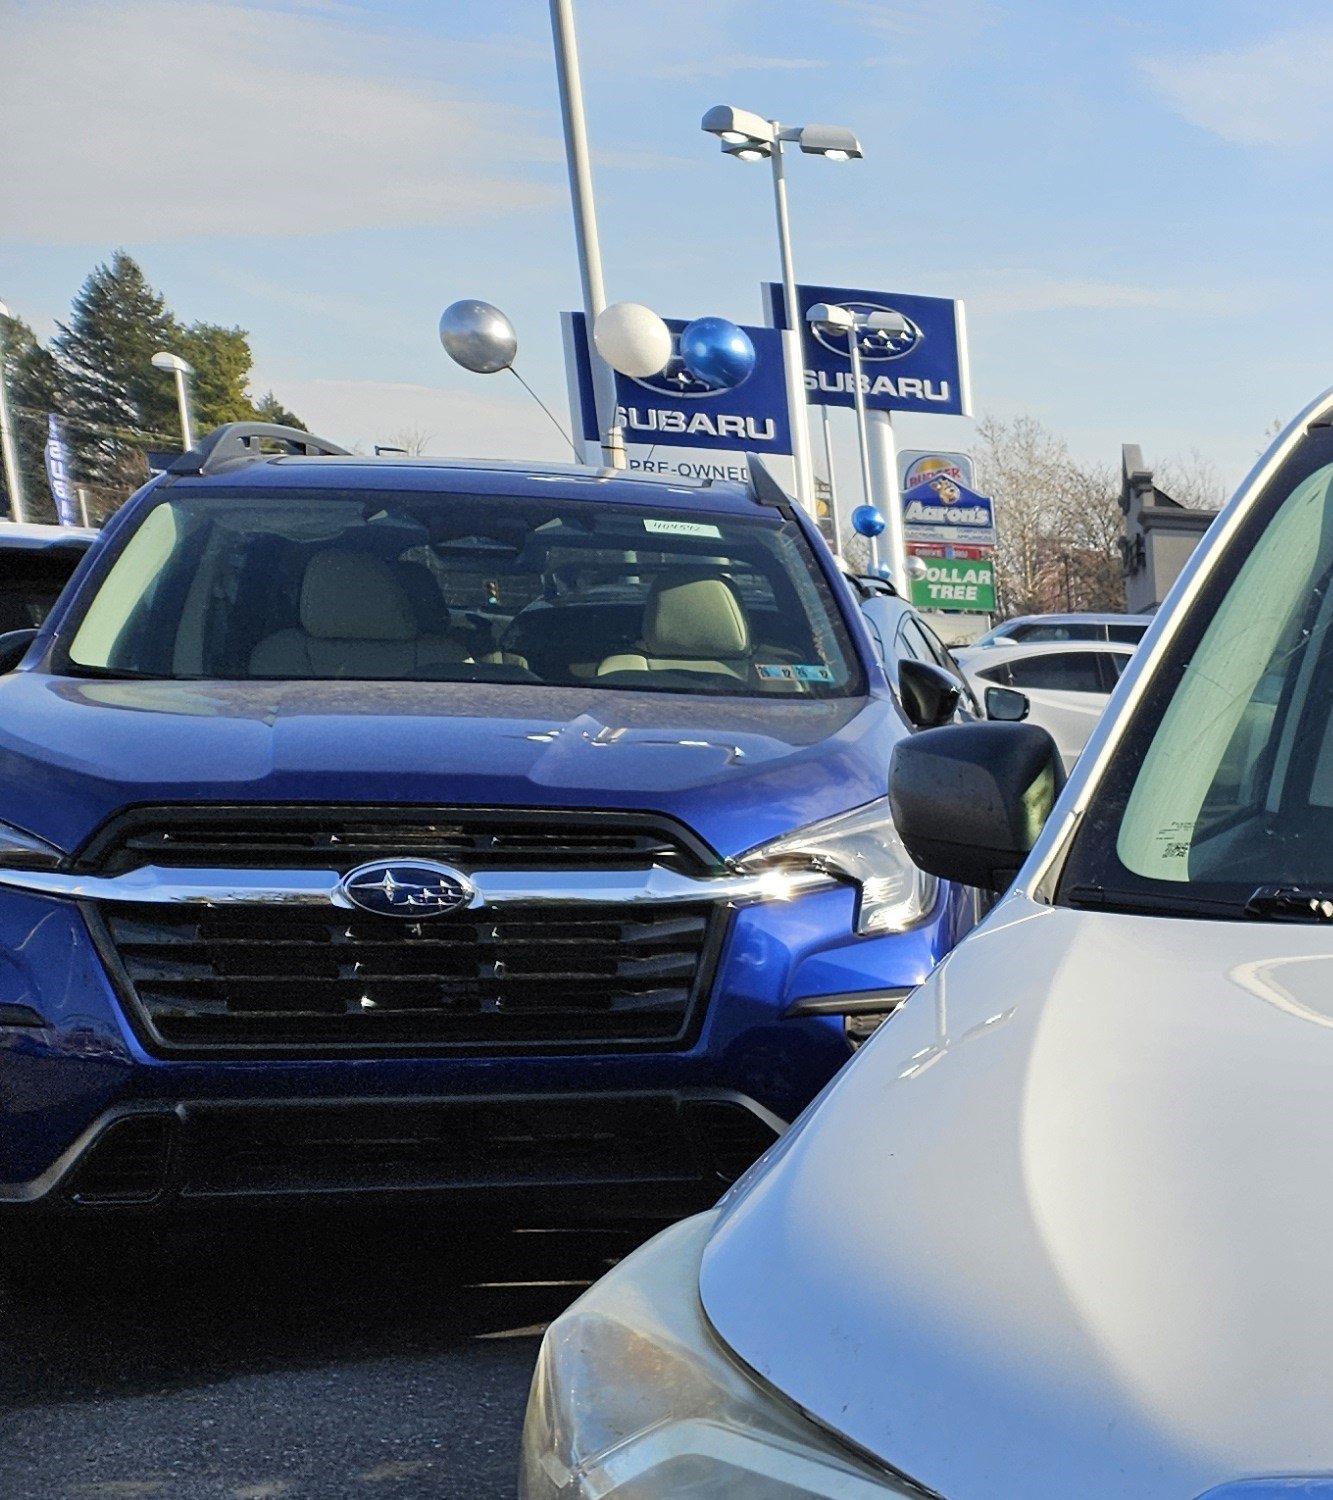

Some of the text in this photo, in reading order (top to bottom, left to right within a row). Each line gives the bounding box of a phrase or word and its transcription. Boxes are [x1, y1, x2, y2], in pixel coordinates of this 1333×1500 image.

[803, 369, 949, 401] SUBARU
[614, 405, 775, 440] SUBARU
[905, 500, 989, 523] Aaron's
[926, 567, 991, 585] OLLAR
[928, 584, 978, 601] TREE
